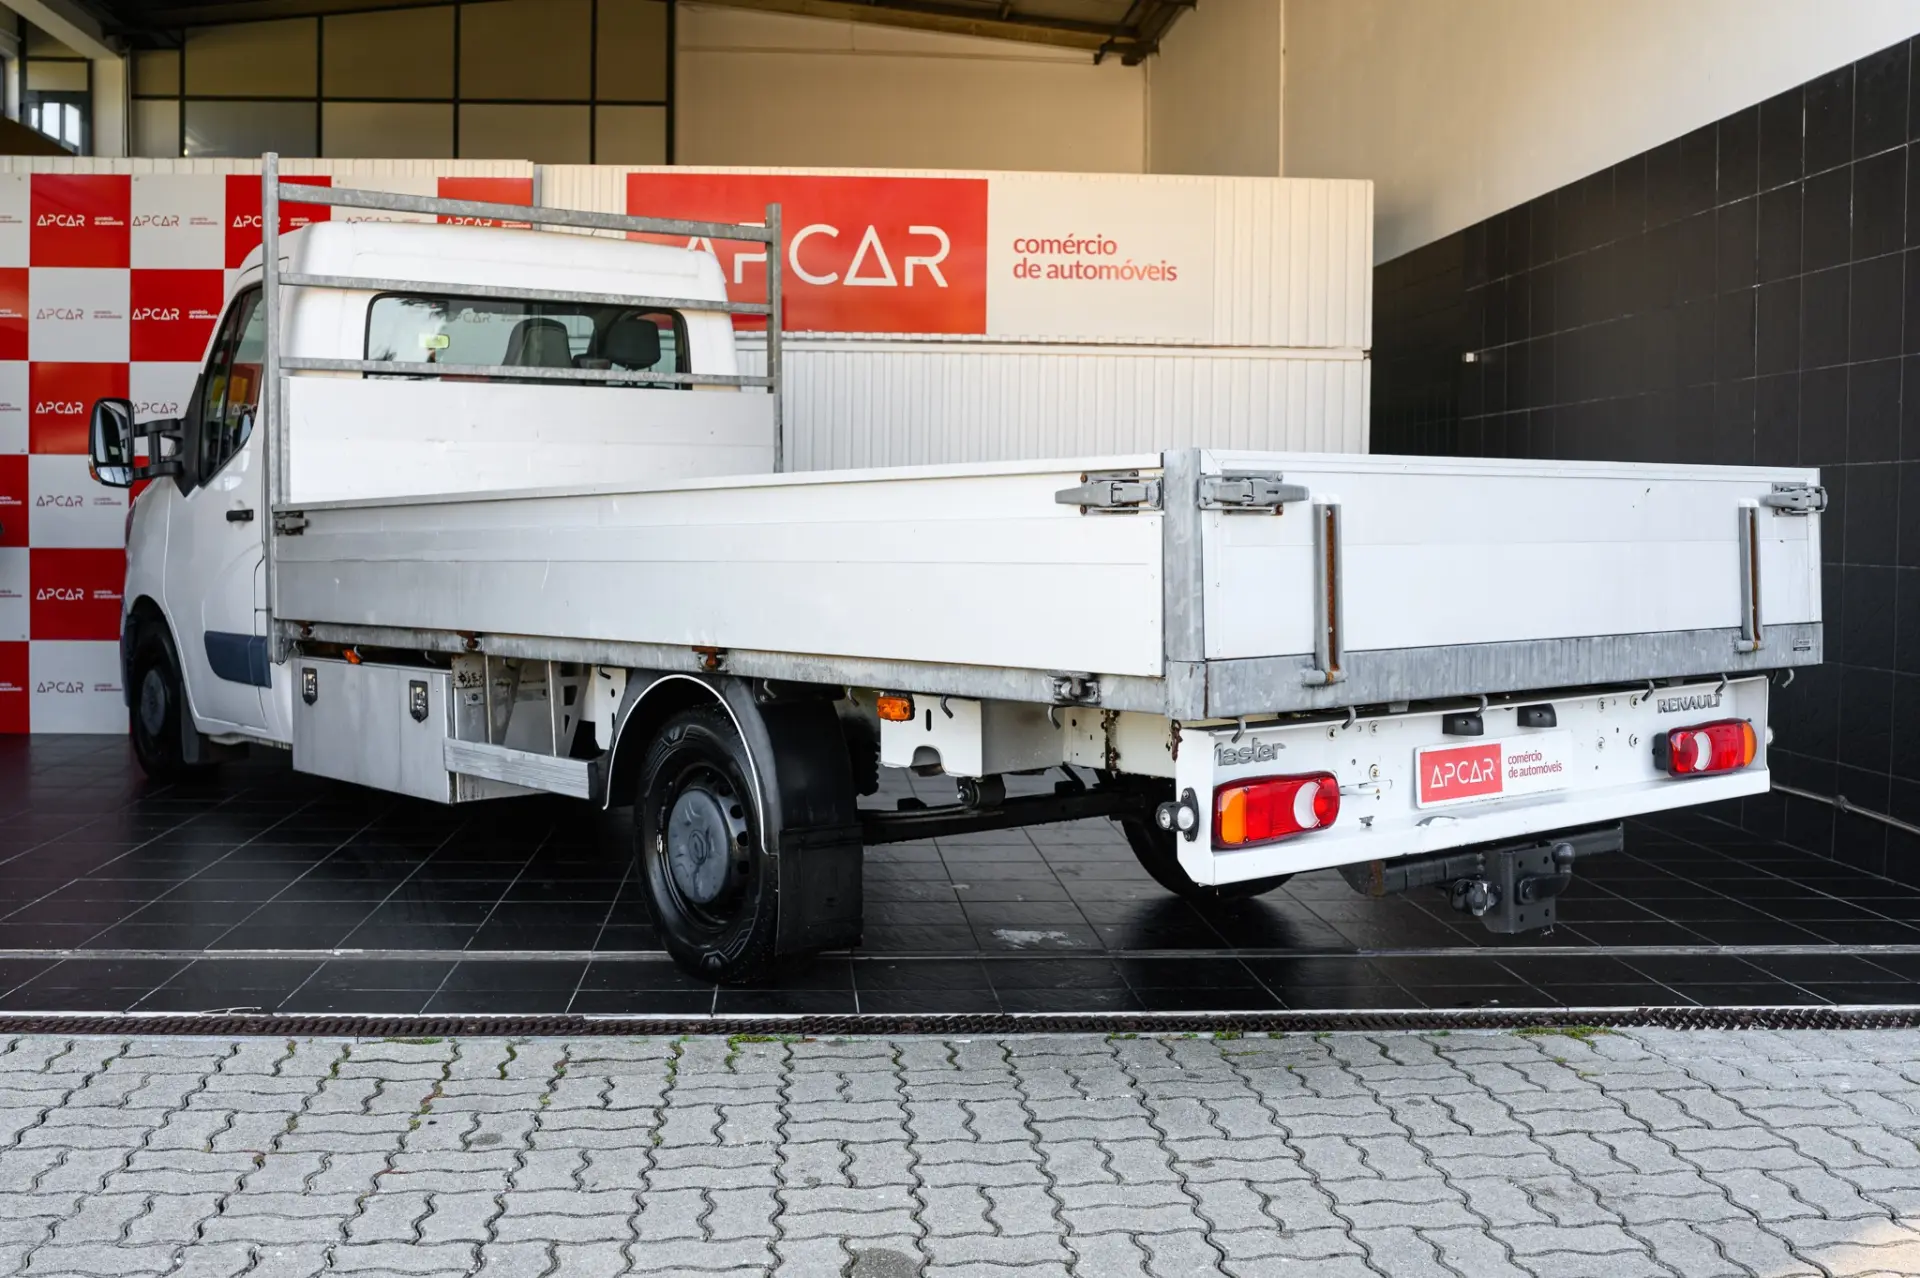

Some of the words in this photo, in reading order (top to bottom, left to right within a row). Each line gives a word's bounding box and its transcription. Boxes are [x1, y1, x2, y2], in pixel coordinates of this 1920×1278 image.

[36, 214, 85, 227] APCAR
[132, 214, 180, 227] APCAR
[232, 215, 281, 227] APC
[1013, 233, 1118, 255] comércio
[1013, 257, 1042, 279] de
[1046, 259, 1178, 281] automóveis
[36, 308, 84, 320] APCAR
[132, 308, 180, 320] APCAR
[35, 401, 84, 414] APCAR
[133, 402, 178, 414] APCAR
[36, 495, 84, 507] APCAR
[36, 588, 84, 600] APCAR
[37, 681, 84, 694] APCAR
[1657, 693, 1723, 714] RENAULT
[1508, 750, 1543, 765] comércio
[1430, 758, 1495, 788] APCAR
[1508, 767, 1519, 778] de
[1519, 760, 1563, 777] automóveis
